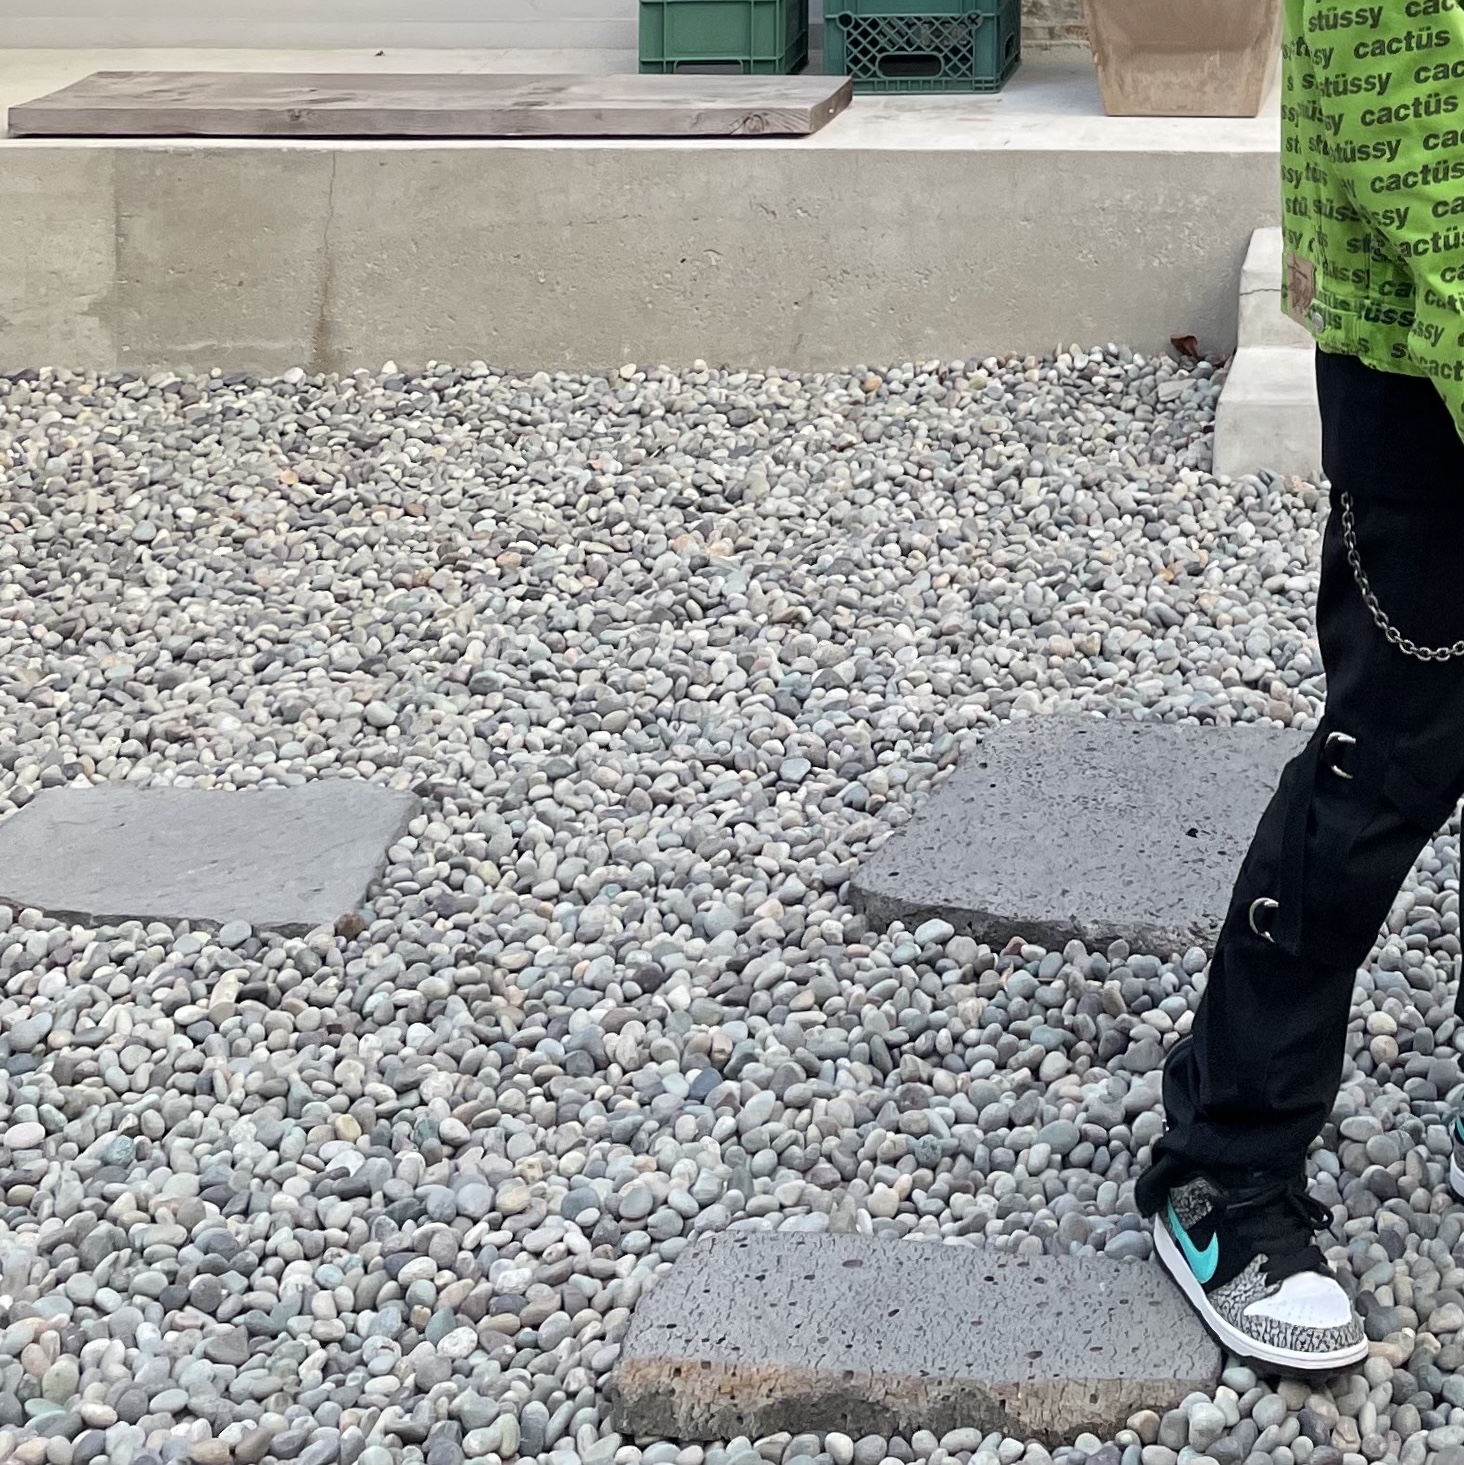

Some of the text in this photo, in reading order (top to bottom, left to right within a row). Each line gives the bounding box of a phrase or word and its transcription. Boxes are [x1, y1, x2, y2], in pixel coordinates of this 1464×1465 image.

[1308, 5, 1384, 33] stüssy
[1353, 26, 1451, 60] cactüs
[1360, 93, 1460, 128] cactüs
